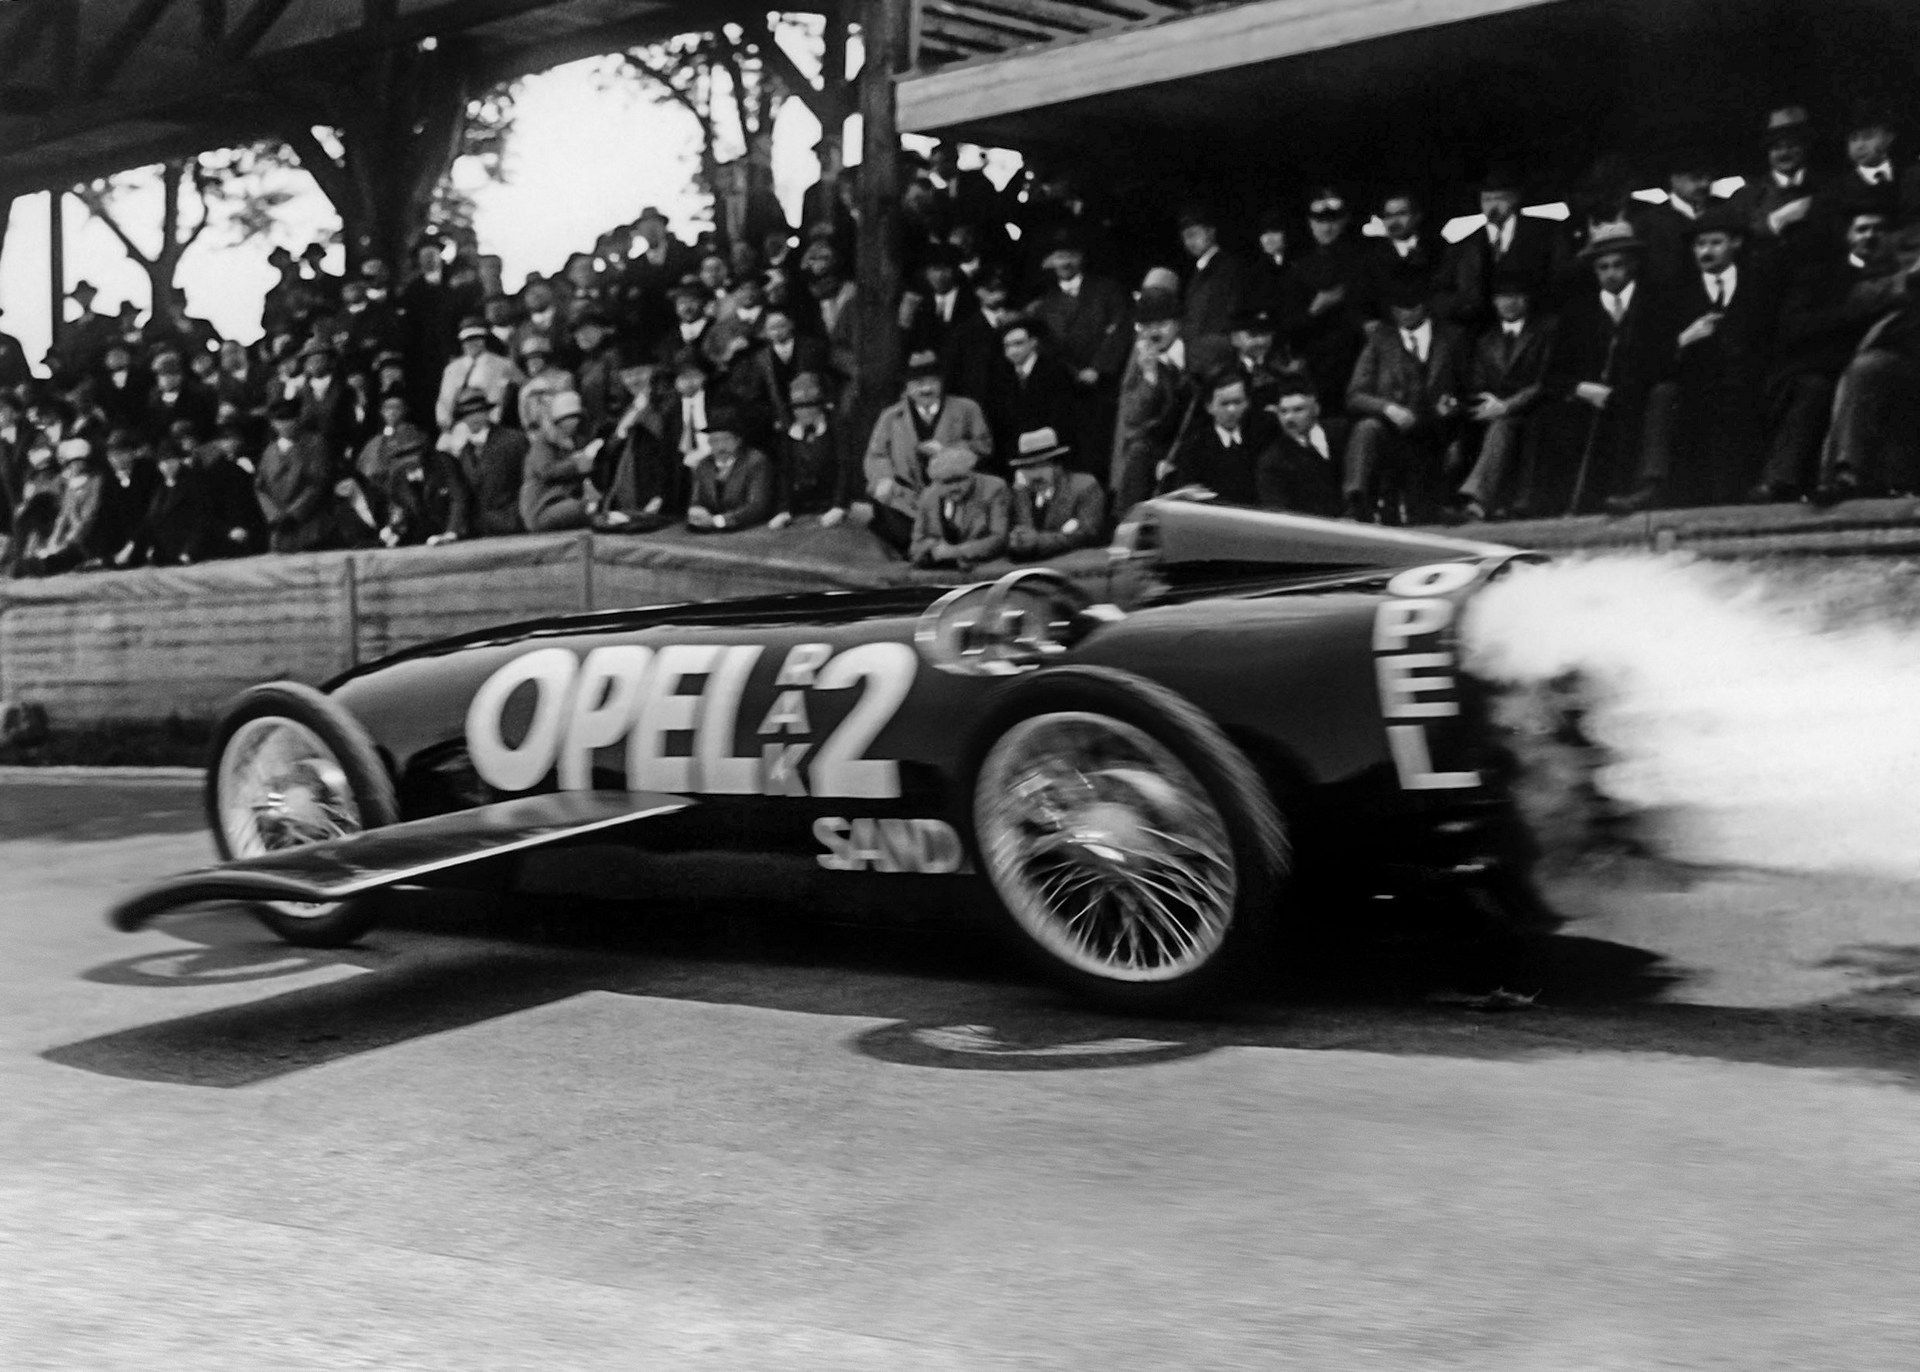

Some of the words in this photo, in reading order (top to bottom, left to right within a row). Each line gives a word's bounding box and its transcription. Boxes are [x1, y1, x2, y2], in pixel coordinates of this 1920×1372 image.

[465, 645, 765, 795] OPEL
[809, 642, 917, 798] 2
[1372, 563, 1482, 790] OPEL
[812, 816, 975, 875] SAND
